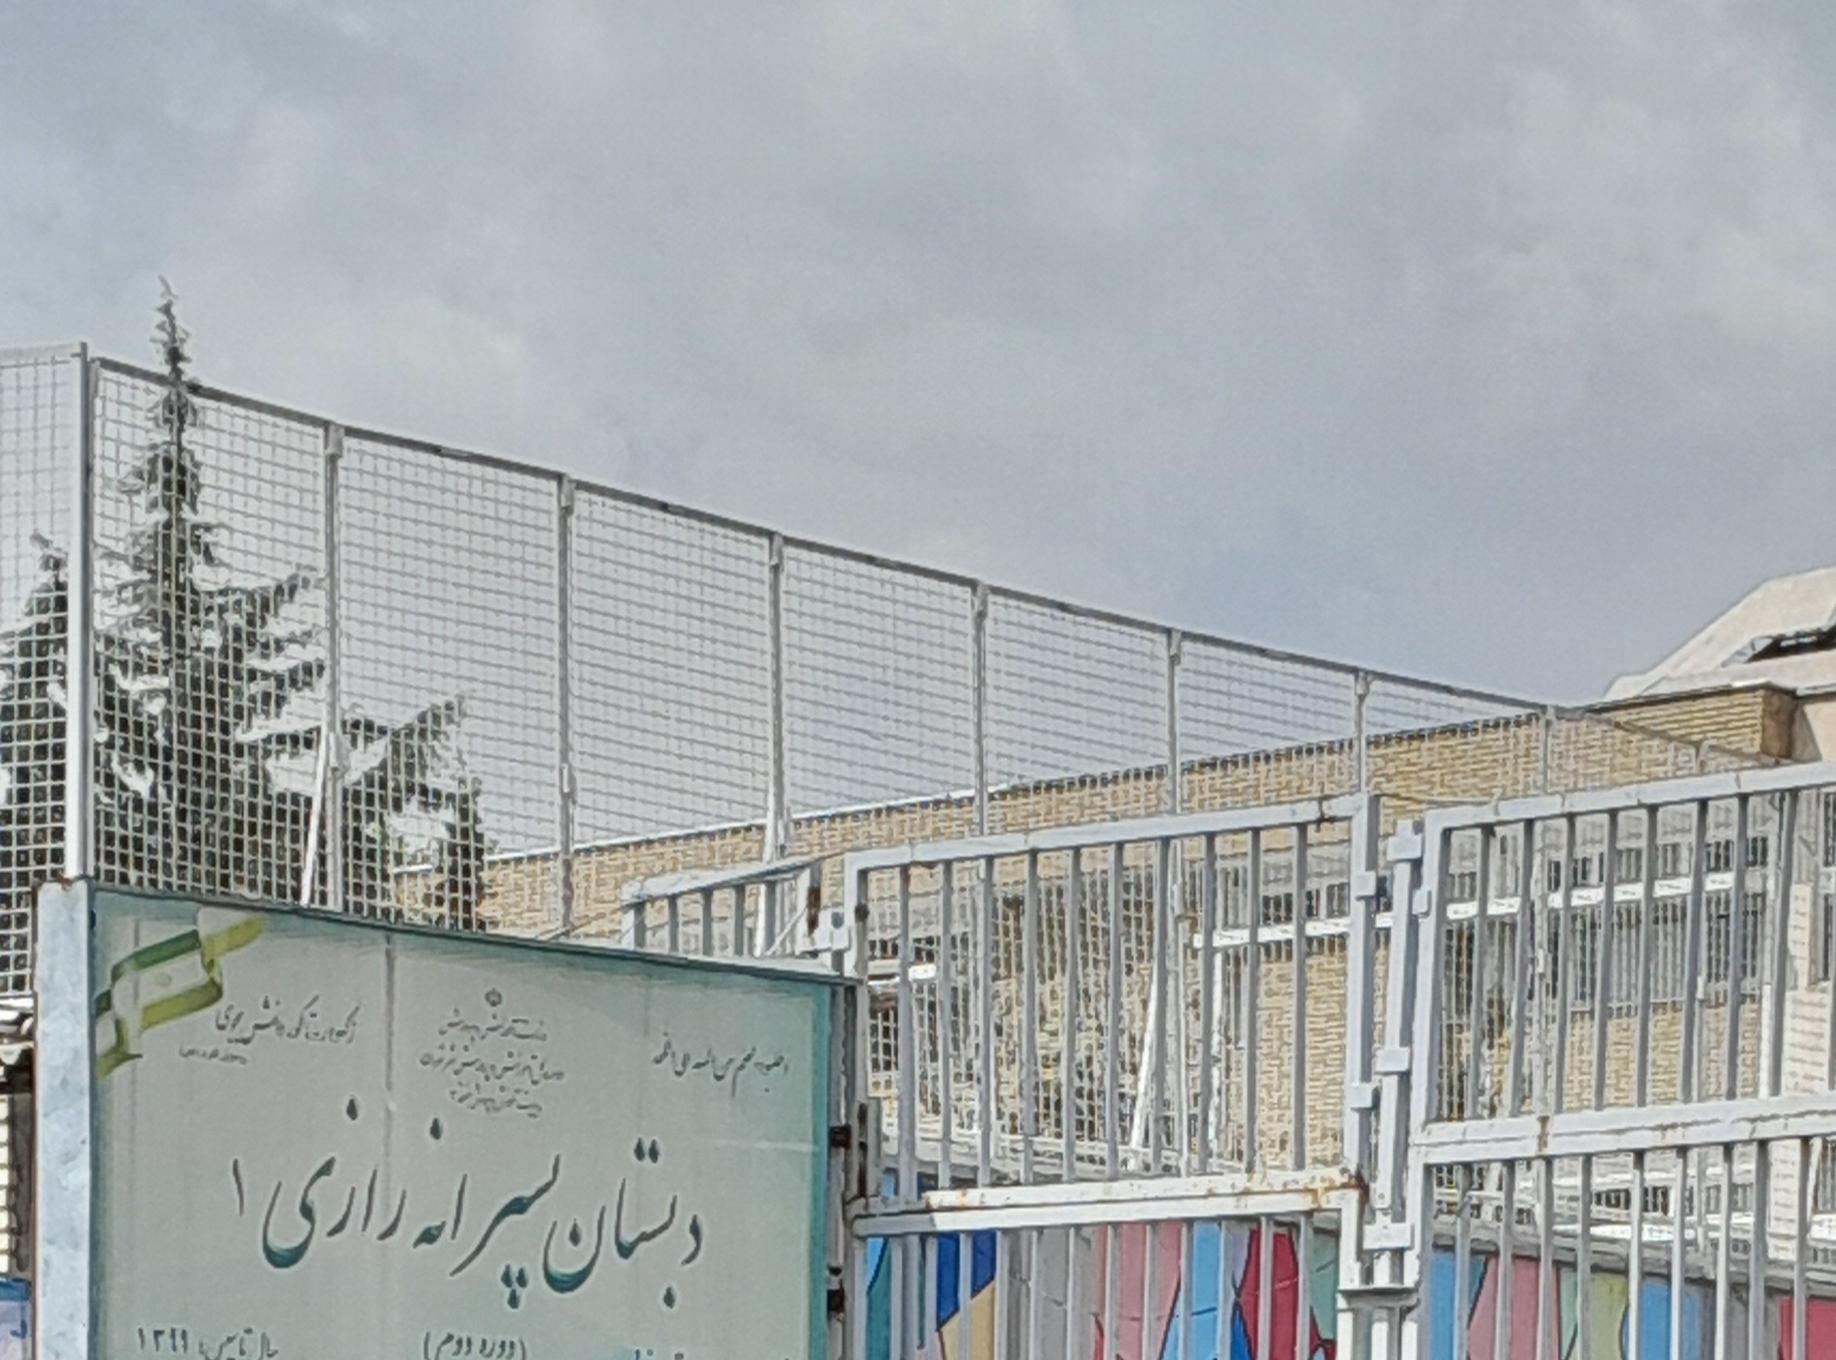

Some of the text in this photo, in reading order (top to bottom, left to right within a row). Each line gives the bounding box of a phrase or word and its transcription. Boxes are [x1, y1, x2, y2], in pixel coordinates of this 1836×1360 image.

[262, 1096, 406, 1270] رازی
[412, 1117, 561, 1310] پسرانه
[543, 1137, 703, 1310] دبستان
